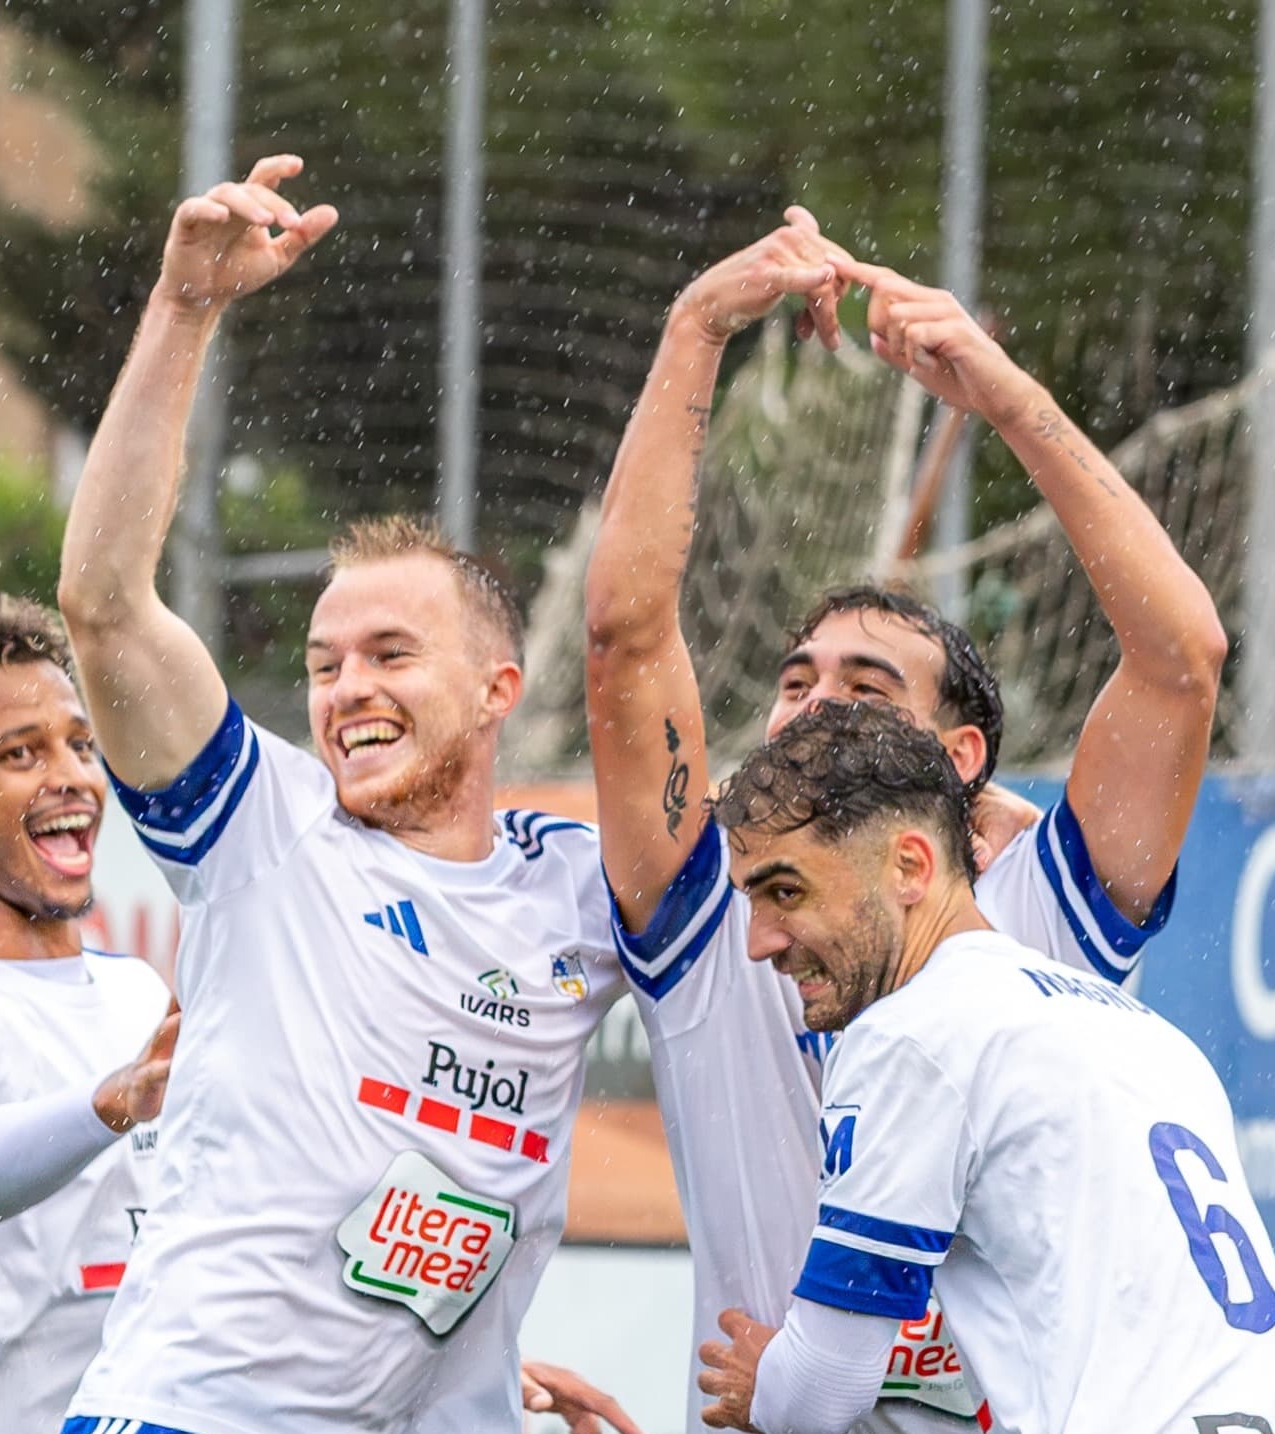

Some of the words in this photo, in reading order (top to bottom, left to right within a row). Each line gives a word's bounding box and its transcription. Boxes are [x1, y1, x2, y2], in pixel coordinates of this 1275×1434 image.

[460, 993, 531, 1027] IVARS
[421, 1041, 529, 1116] Pujol
[369, 1186, 492, 1255] litera
[382, 1241, 490, 1293] meat
